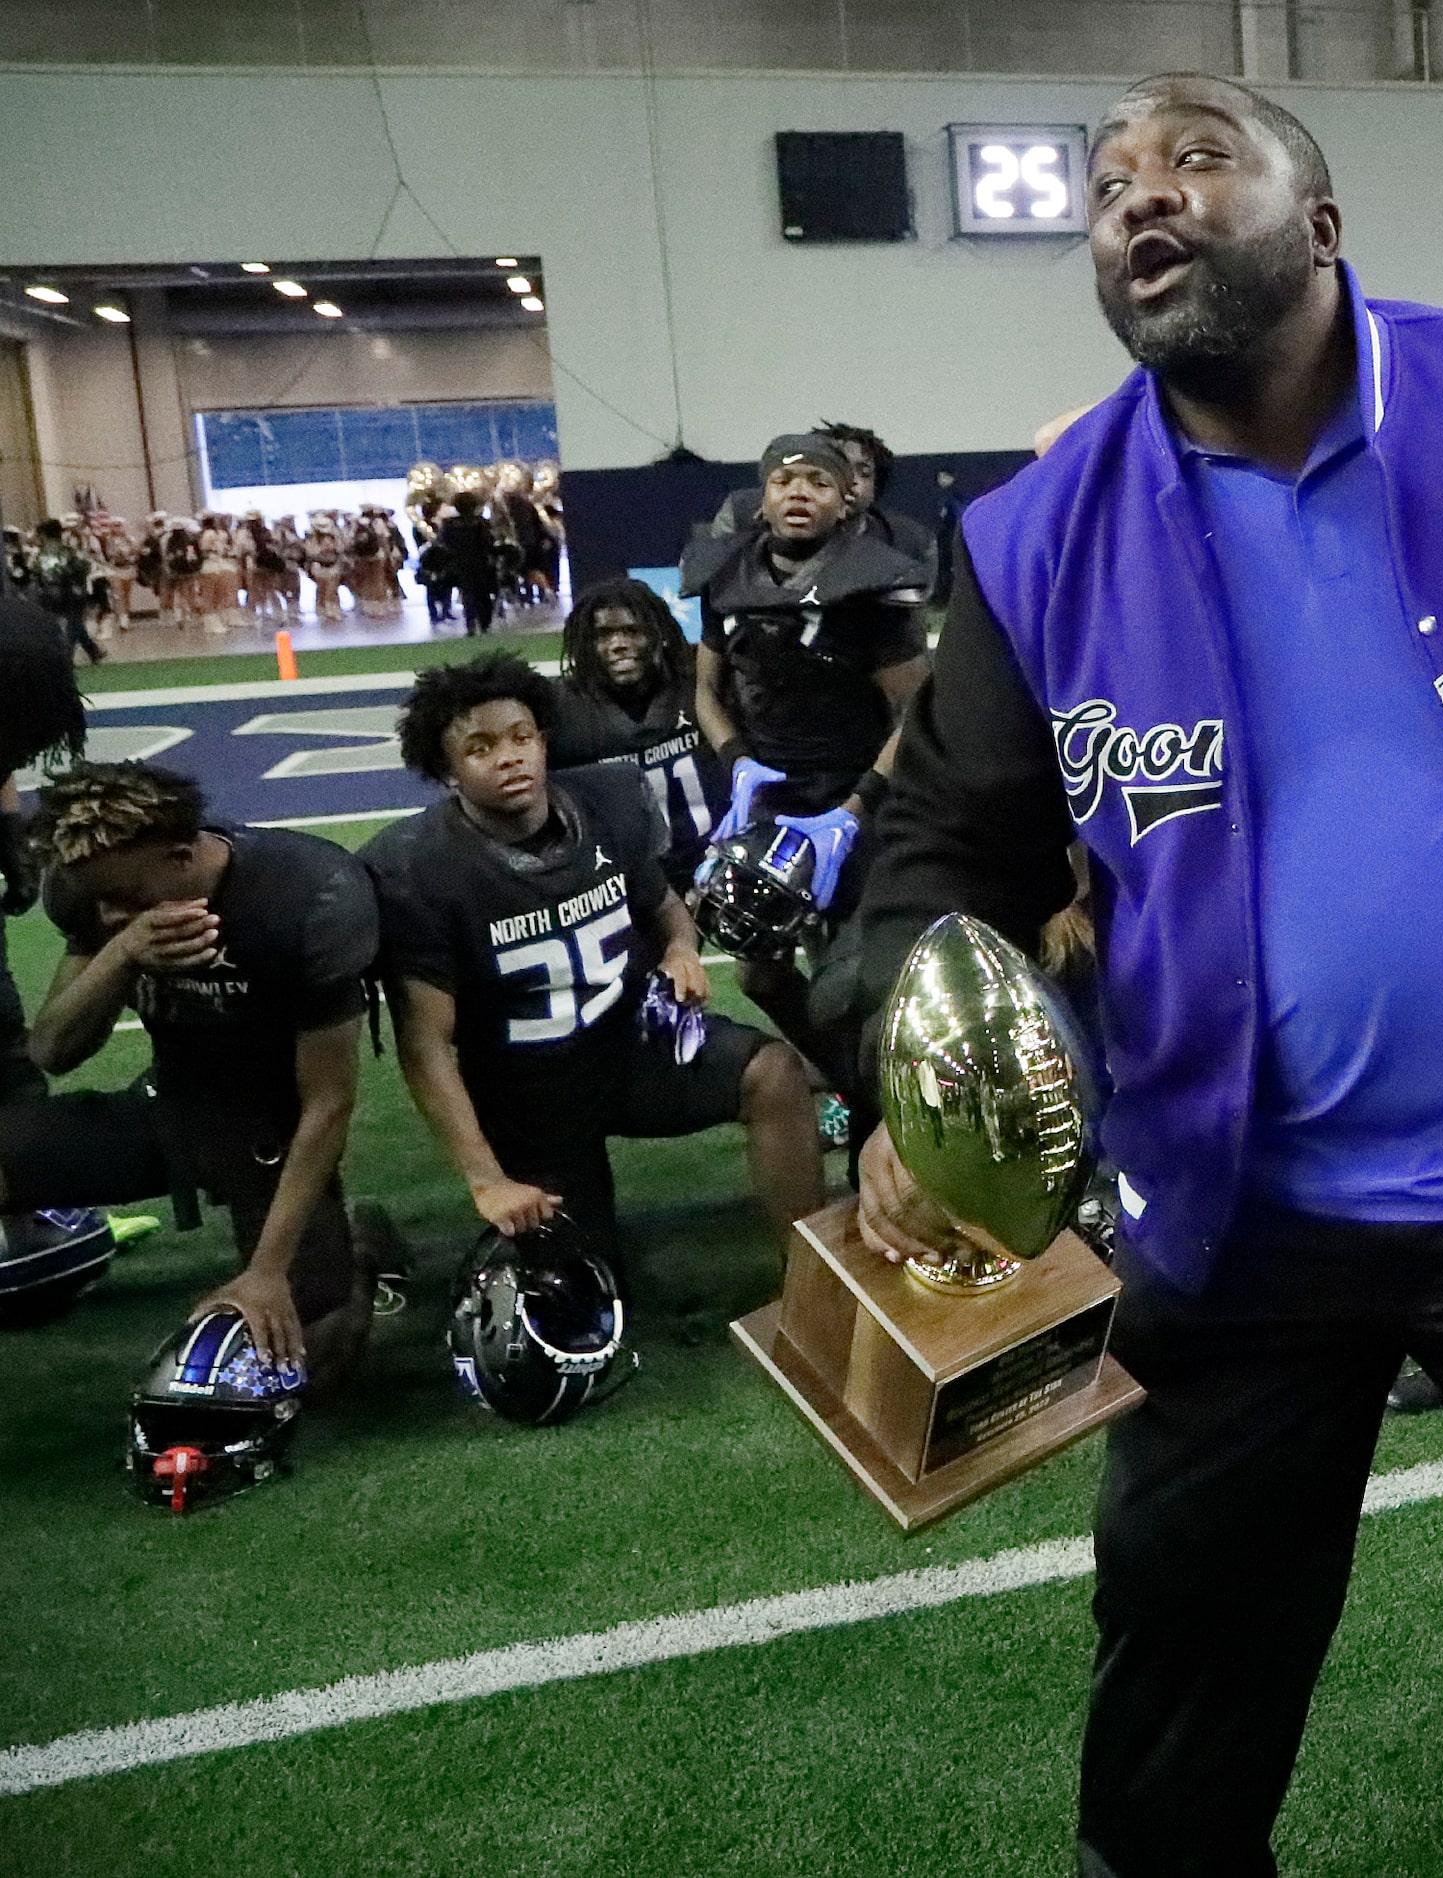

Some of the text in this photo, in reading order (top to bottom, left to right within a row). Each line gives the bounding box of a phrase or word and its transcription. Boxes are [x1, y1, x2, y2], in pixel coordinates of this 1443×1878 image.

[976, 145, 1067, 218] 25
[643, 730, 700, 766] CROWLEY
[489, 872, 628, 947] NORTH CROWLEY
[495, 903, 633, 1042] 35
